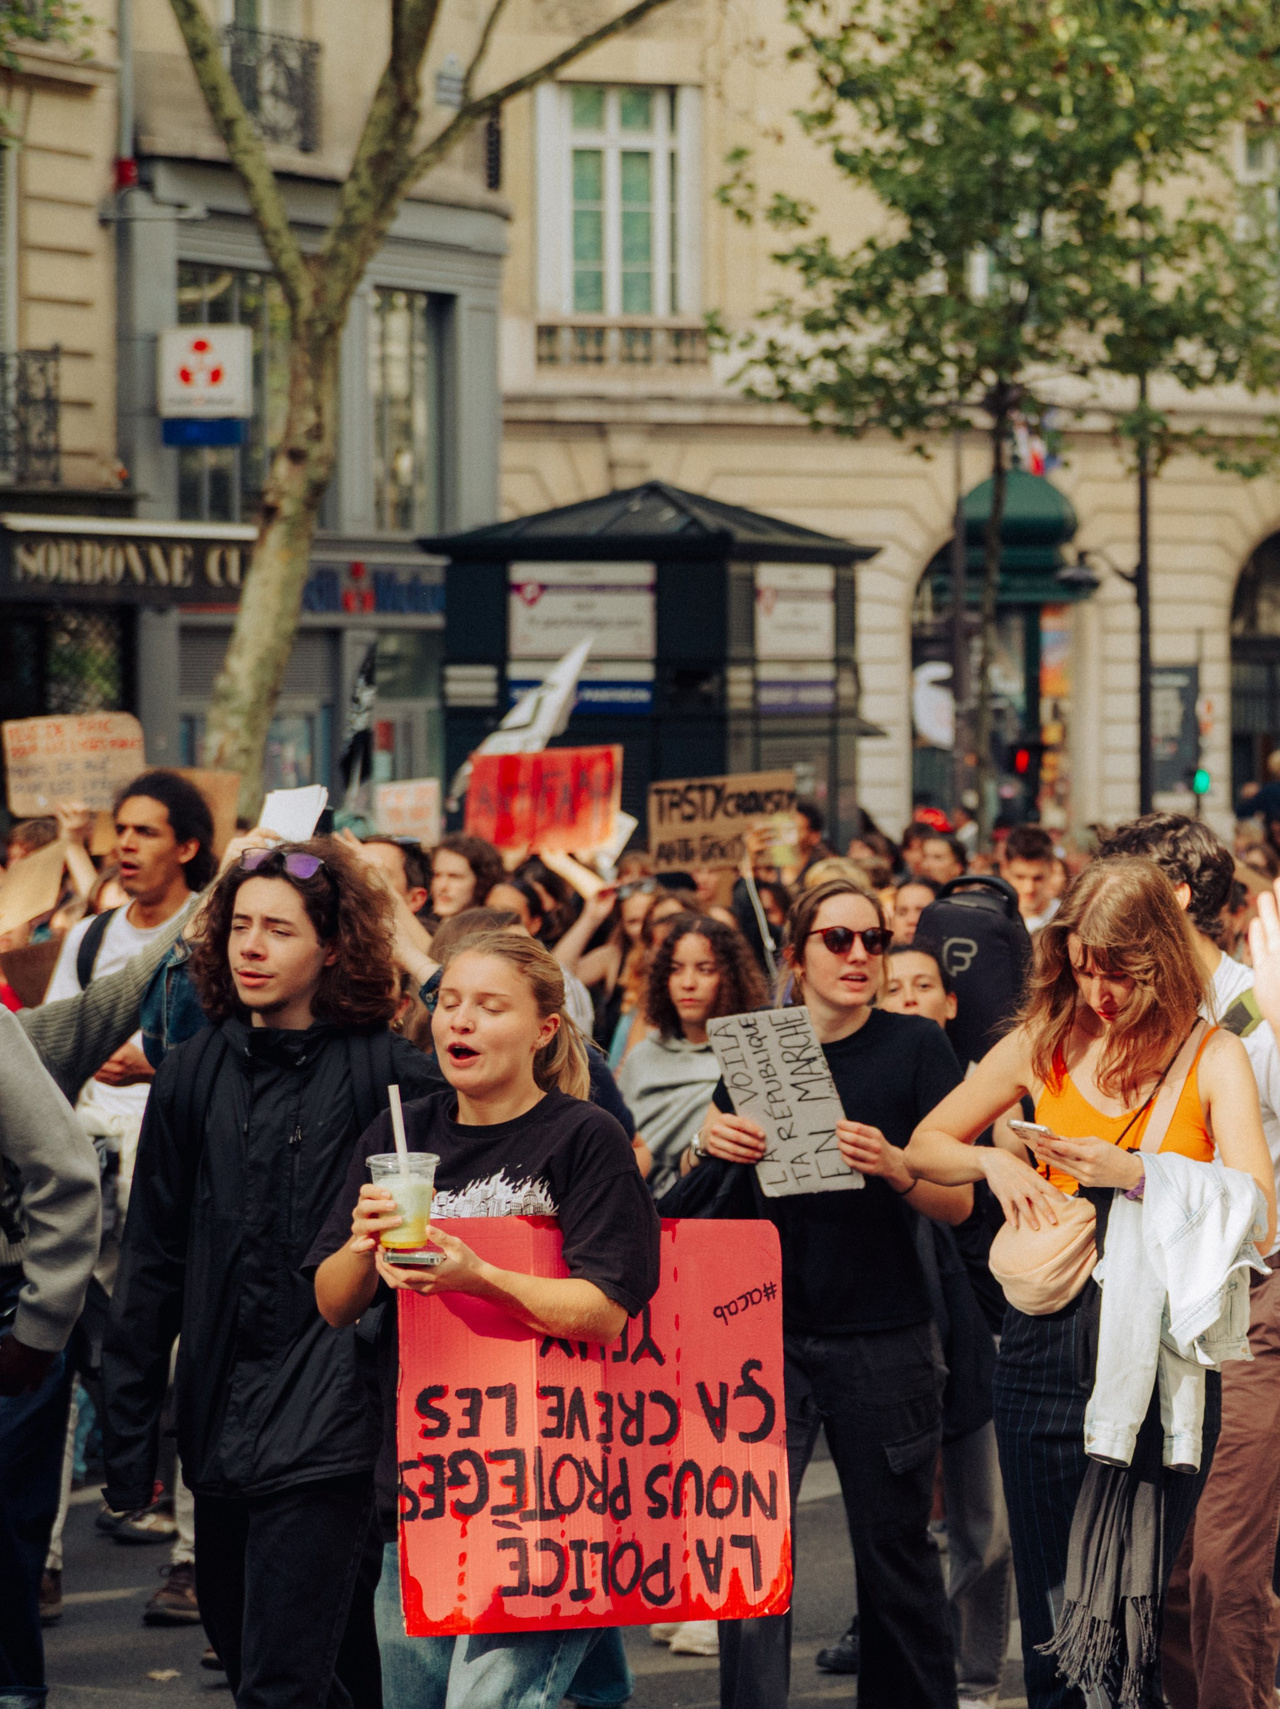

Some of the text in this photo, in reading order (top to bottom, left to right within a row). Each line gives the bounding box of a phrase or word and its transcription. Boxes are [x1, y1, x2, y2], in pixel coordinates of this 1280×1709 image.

[15, 539, 193, 587] SORBONNE
[768, 1010, 831, 1103] MARCHE
[709, 1022, 789, 1187] LA VOILÀ
[738, 1016, 813, 1187] TA RÉPUBLIQUE
[809, 1128, 854, 1179] EN
[712, 1281, 777, 1326] #acab
[415, 1360, 776, 1454] ÇA CRÈVE LES
[398, 1447, 777, 1531] NOUS PROTÈGES
[496, 1535, 762, 1606] LA POLICE
